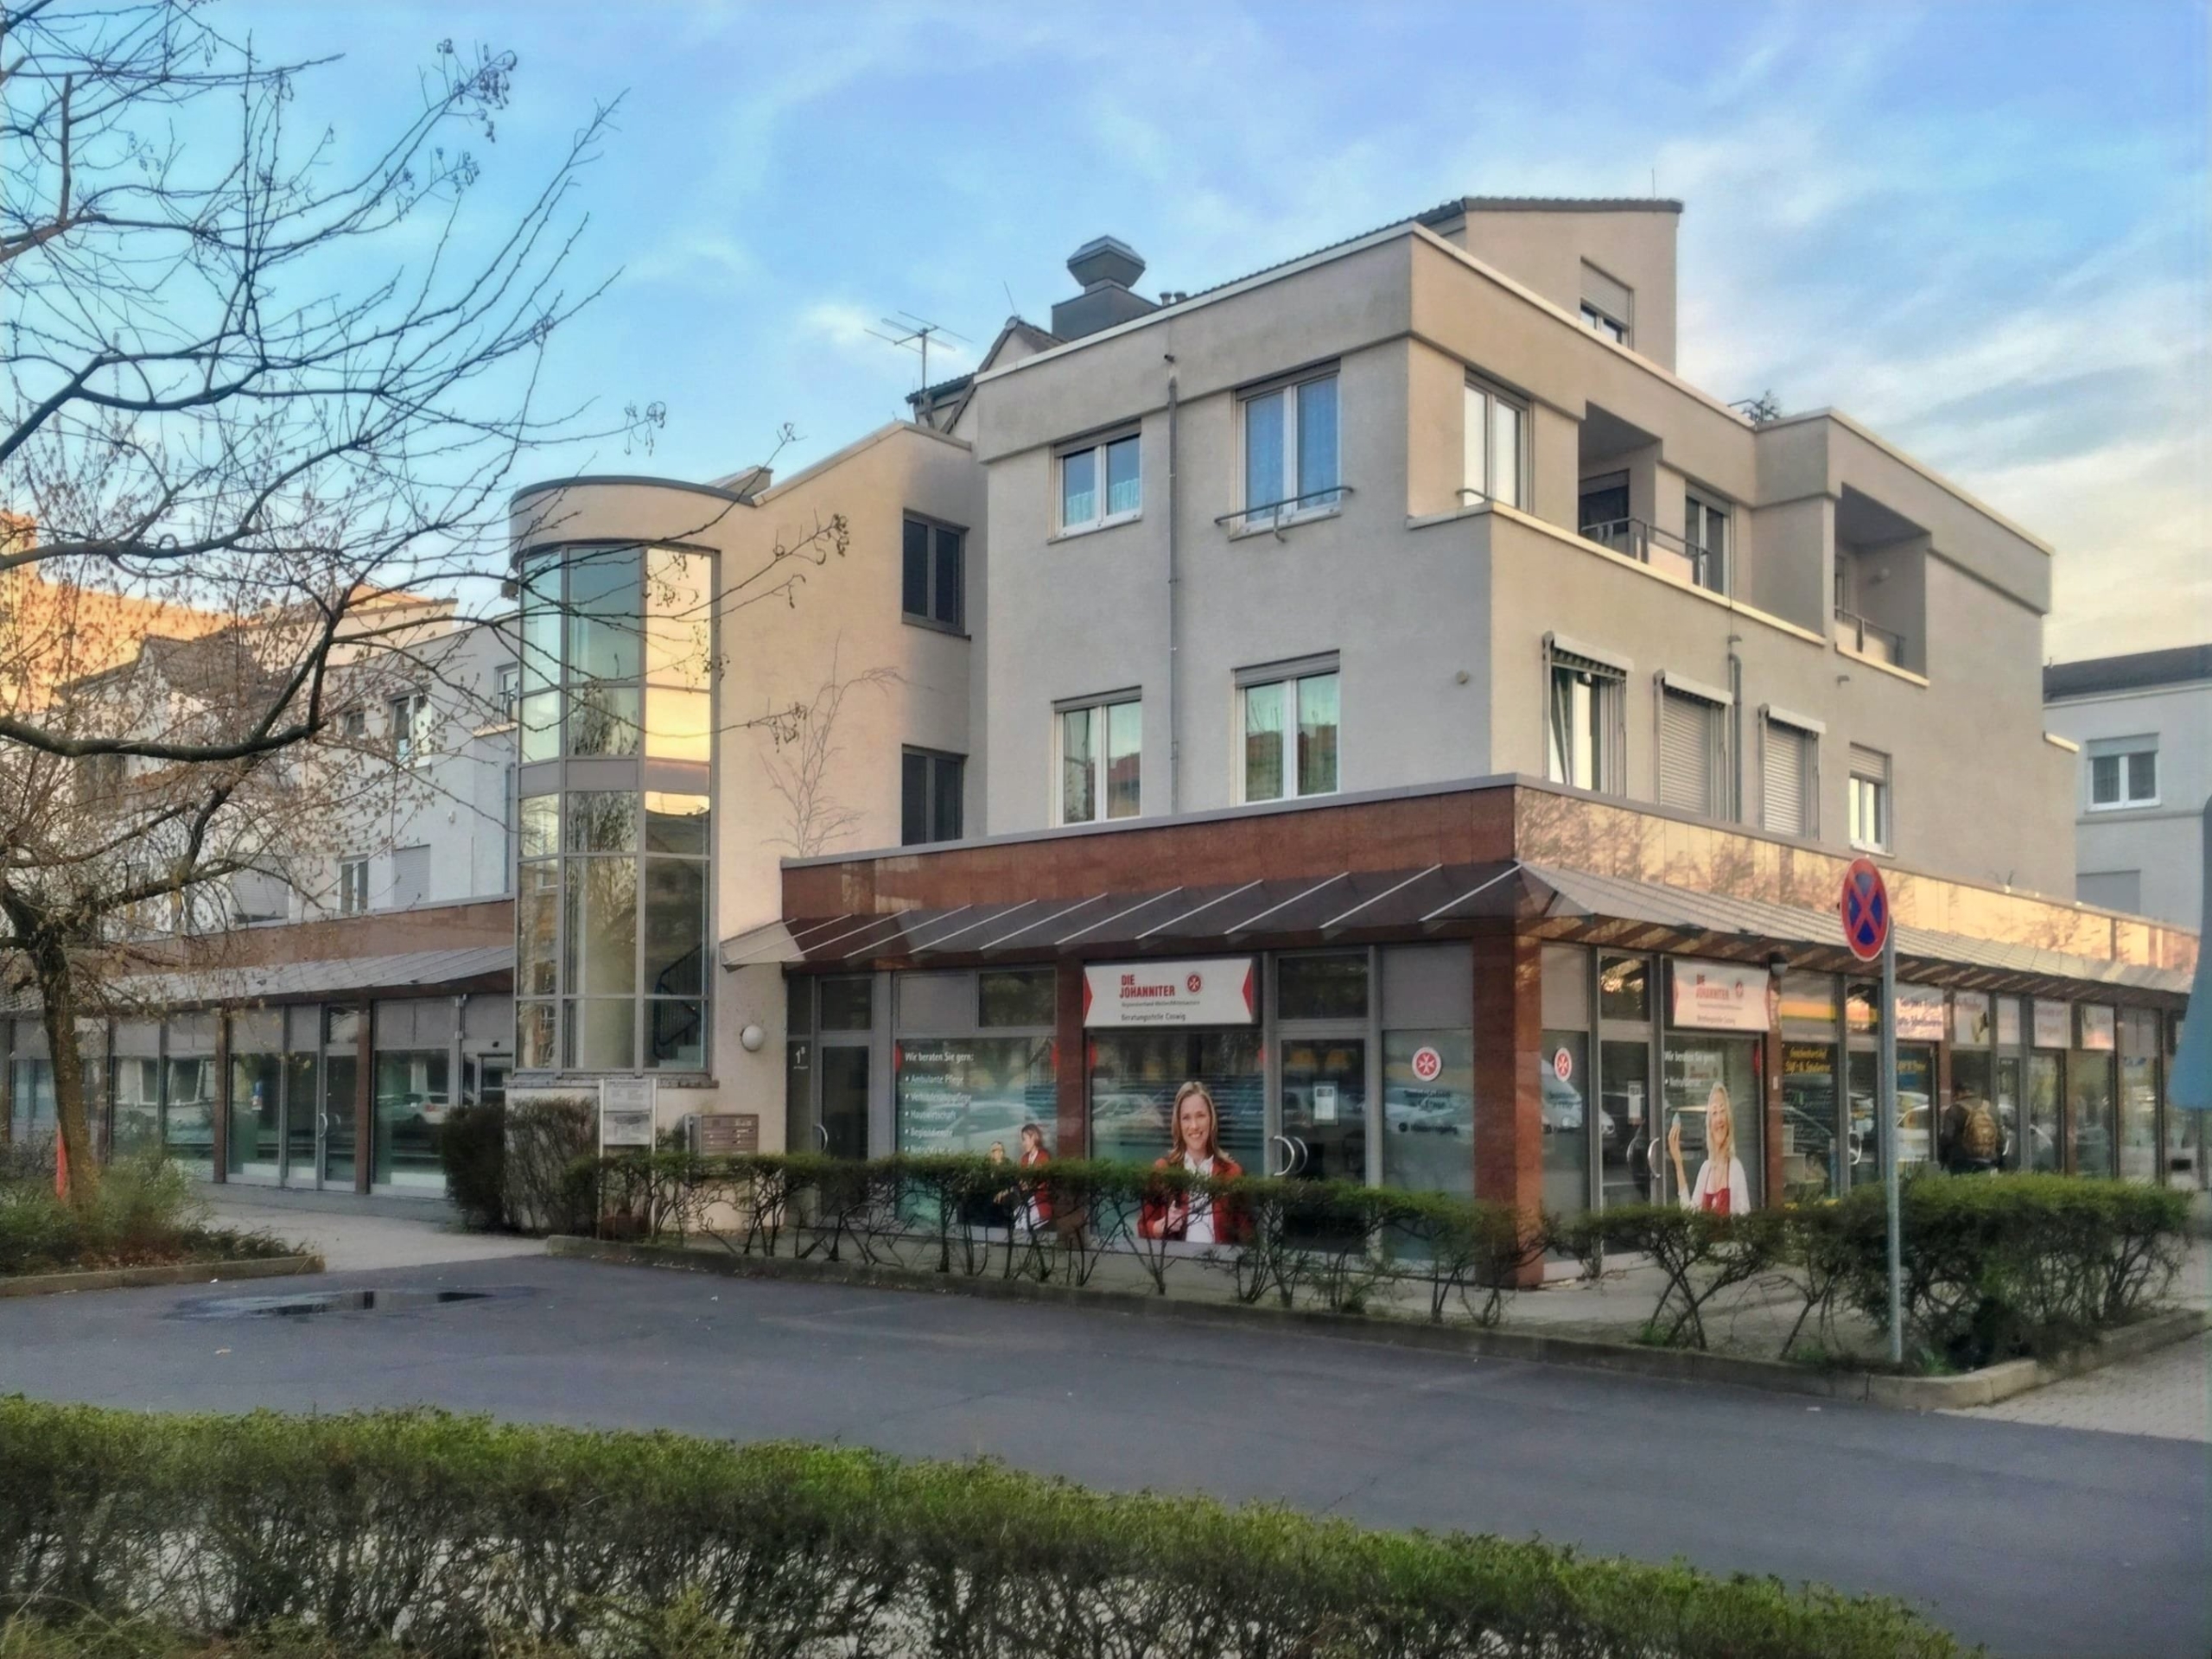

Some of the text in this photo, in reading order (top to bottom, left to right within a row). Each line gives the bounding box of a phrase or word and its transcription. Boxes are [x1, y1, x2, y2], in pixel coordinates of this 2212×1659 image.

[1122, 974, 1135, 986] DIE
[1120, 985, 1175, 999] JOHANNITER
[905, 1051, 975, 1065] Wir beraten Sie gern:
